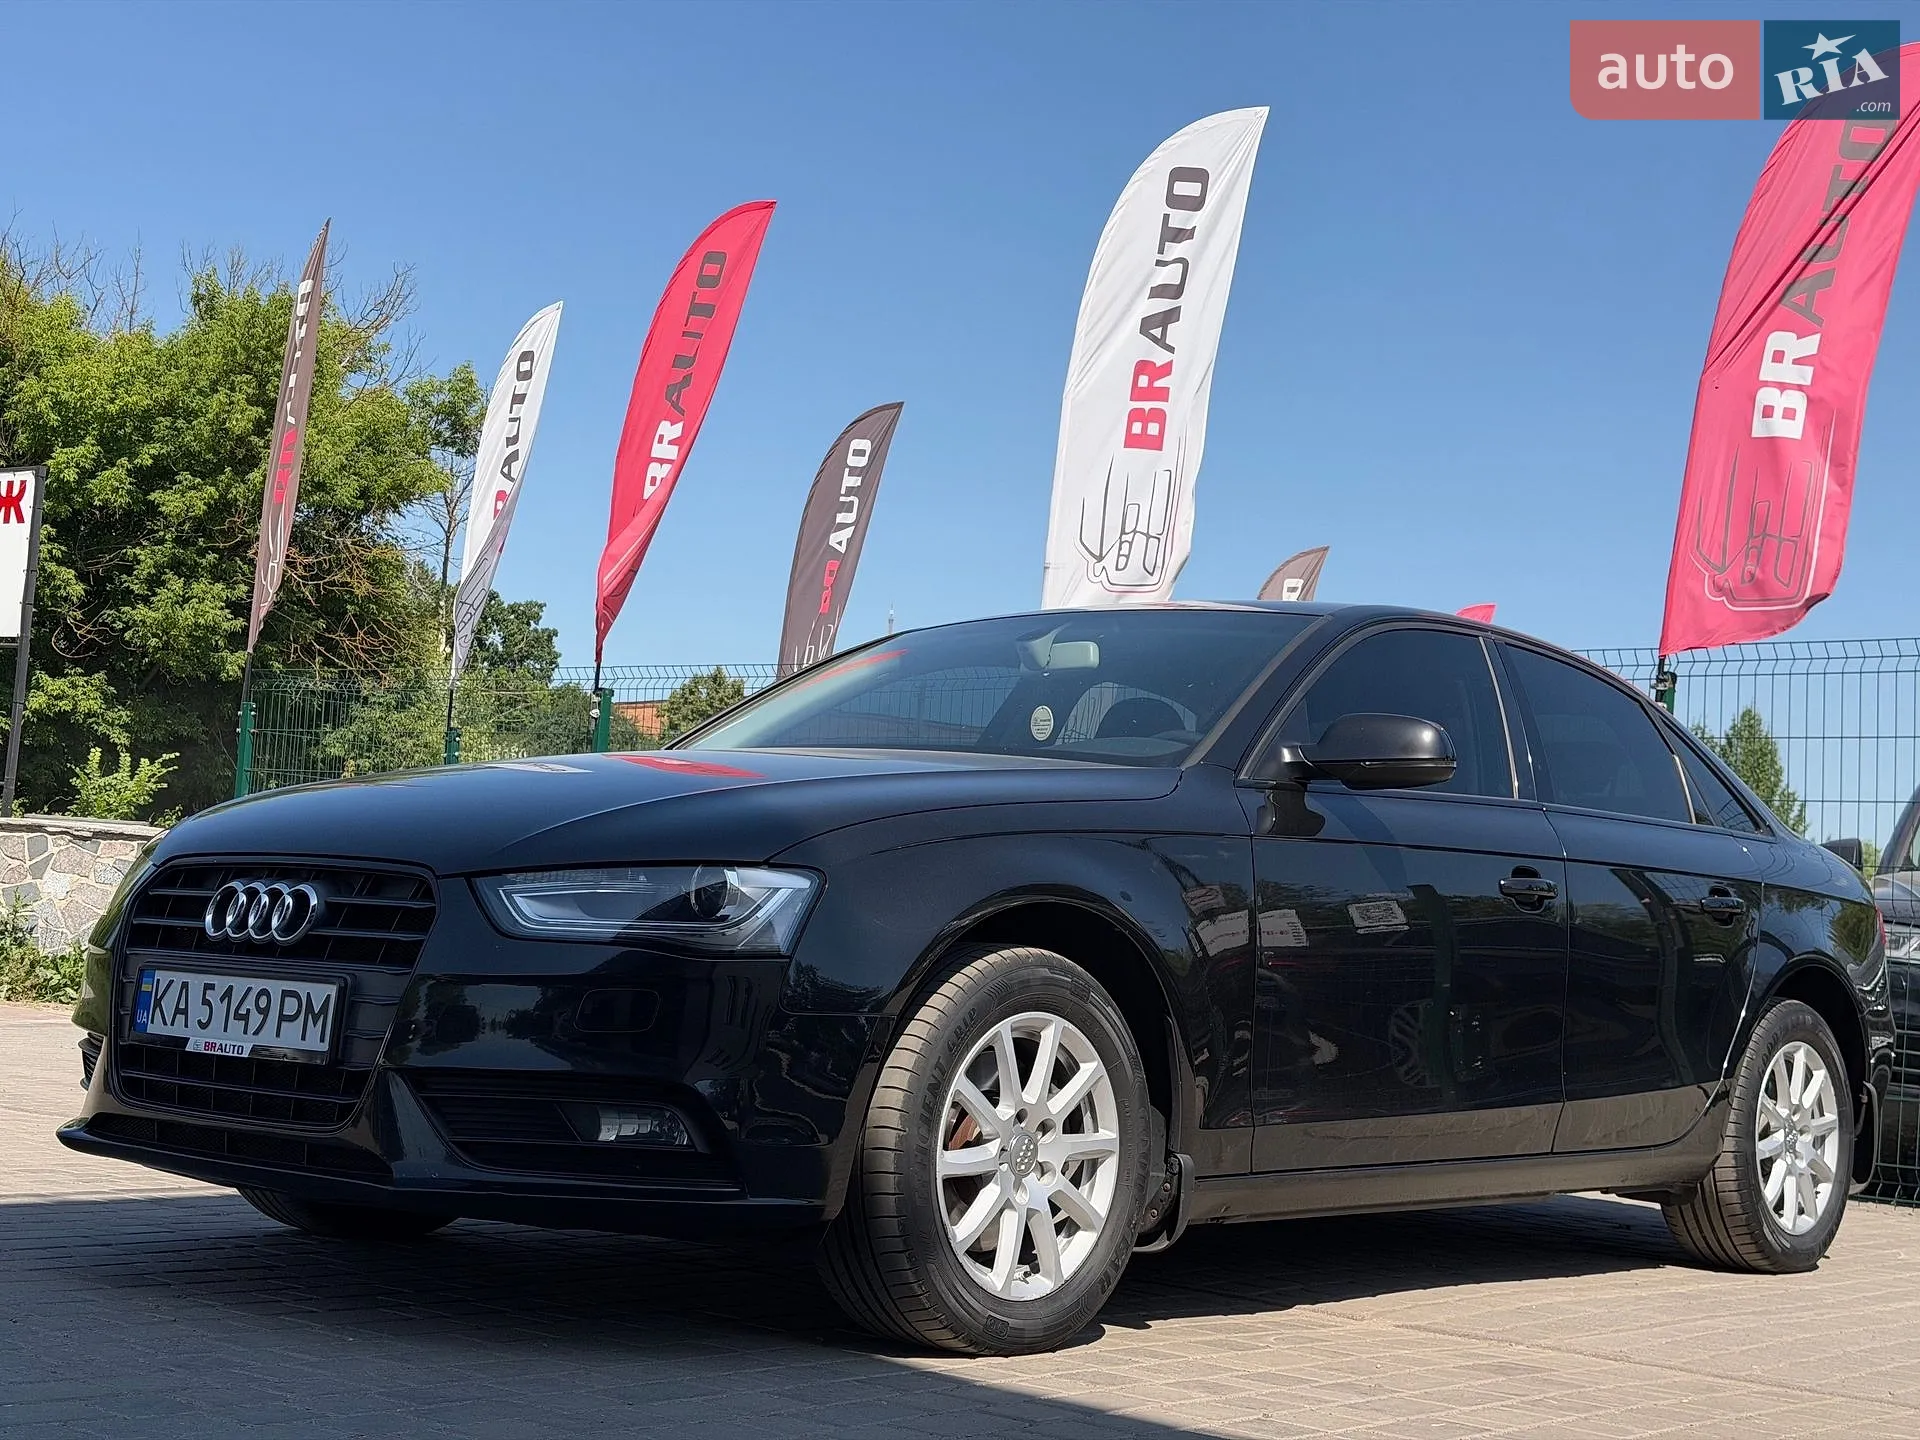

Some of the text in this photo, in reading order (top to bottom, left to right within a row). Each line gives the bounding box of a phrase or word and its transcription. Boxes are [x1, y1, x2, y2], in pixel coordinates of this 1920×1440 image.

[1751, 110, 1900, 440] BRAUTO
[1123, 166, 1210, 452] BRAUTO
[136, 1009, 148, 1024] UA
[150, 978, 332, 1044] KA 5149 PM
[203, 1040, 245, 1056] BRAUTO
